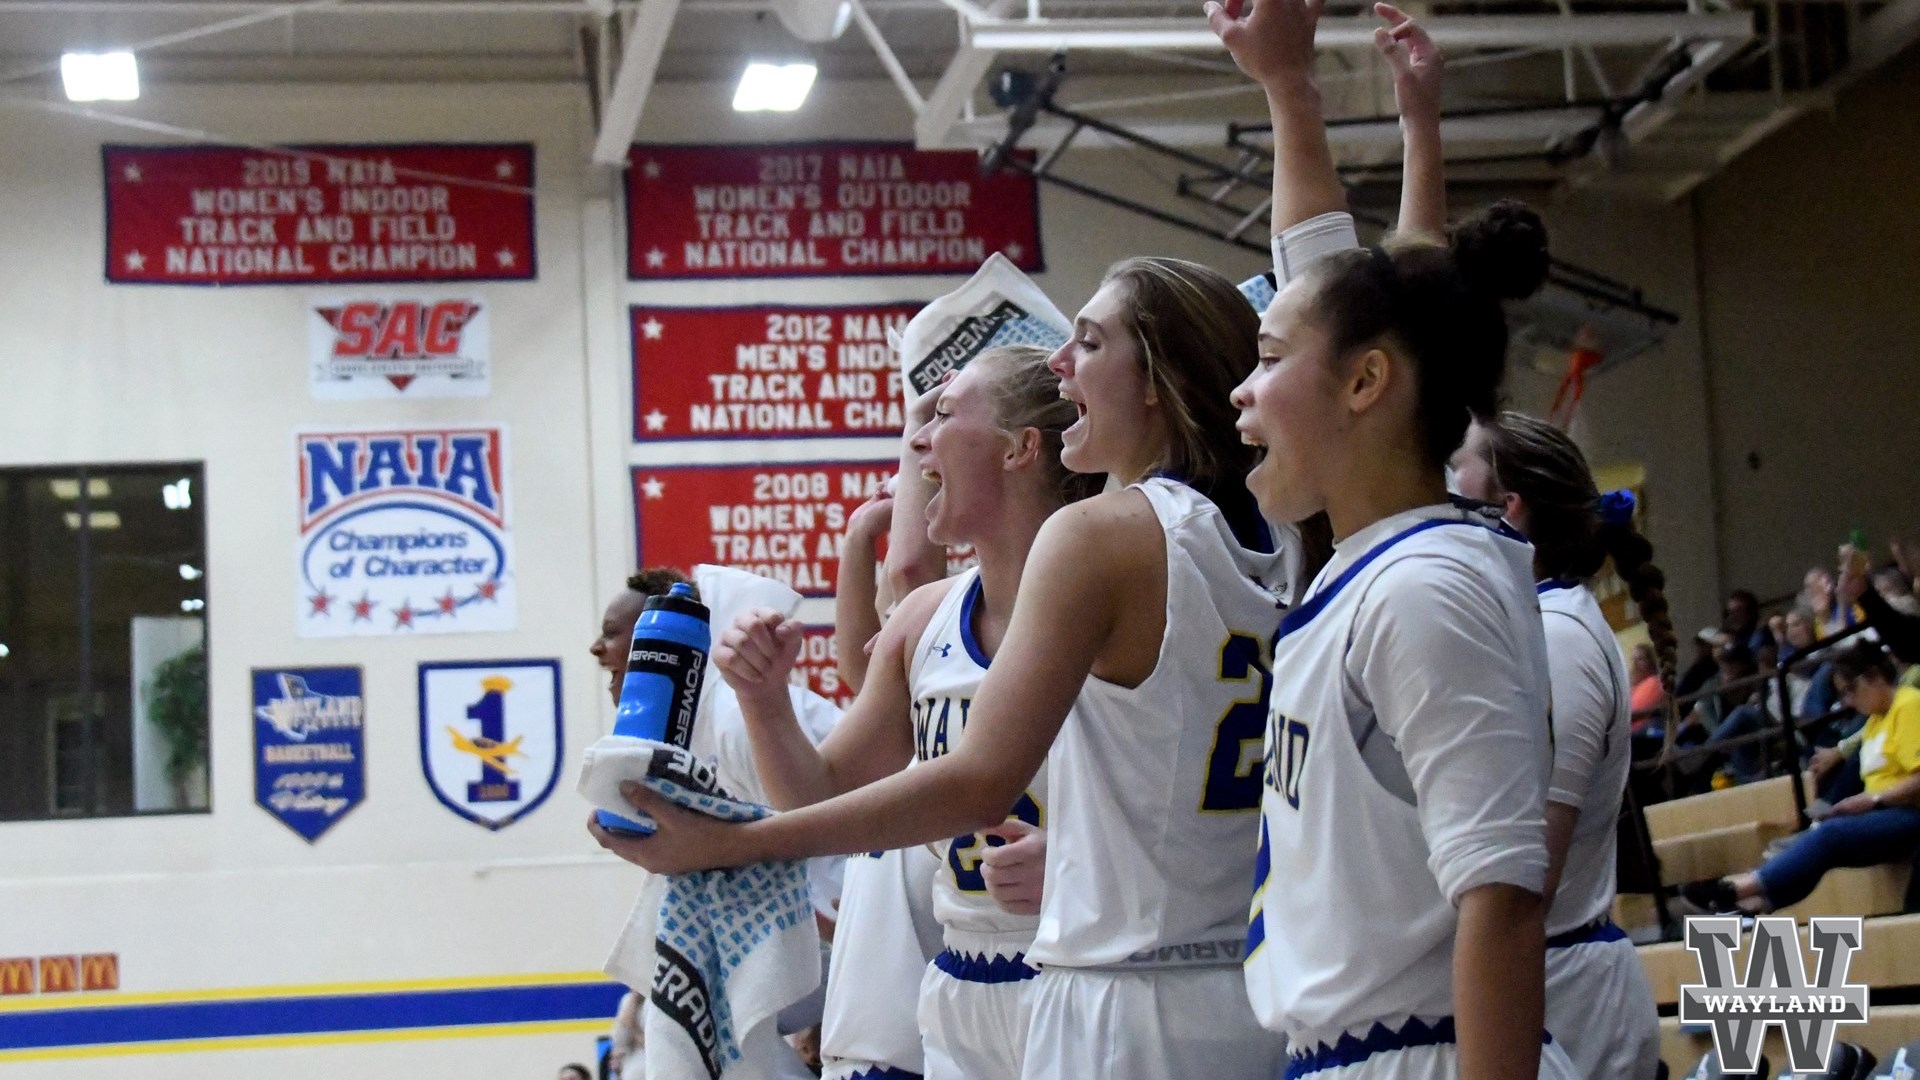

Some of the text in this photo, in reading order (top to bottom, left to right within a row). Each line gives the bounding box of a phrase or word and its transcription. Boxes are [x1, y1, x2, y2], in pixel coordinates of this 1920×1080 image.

[328, 159, 397, 184] NAIA
[760, 156, 905, 183] 2017 NAIA
[192, 187, 450, 216] WOMEN'S INDOOR
[694, 182, 972, 210] WOMEN'S OUTDOOR
[180, 215, 457, 244] TRACK AND FIELD
[697, 211, 965, 239] TRACK AND FIELD
[166, 244, 477, 275] NATIONAL CHAMPION
[684, 239, 985, 269] NATIONAL CHAMPION
[333, 298, 472, 357] SAC
[766, 314, 832, 341] 2012
[736, 344, 827, 371] MEN'S
[708, 373, 805, 401] TRACK
[818, 373, 878, 399] AND
[689, 403, 832, 432] NATIONAL
[306, 437, 494, 515] NAIA
[753, 472, 829, 501] 2008
[709, 504, 845, 532] WOMEN'S
[328, 529, 469, 554] Champions
[710, 534, 806, 562] TRACK
[328, 555, 488, 578] of Character
